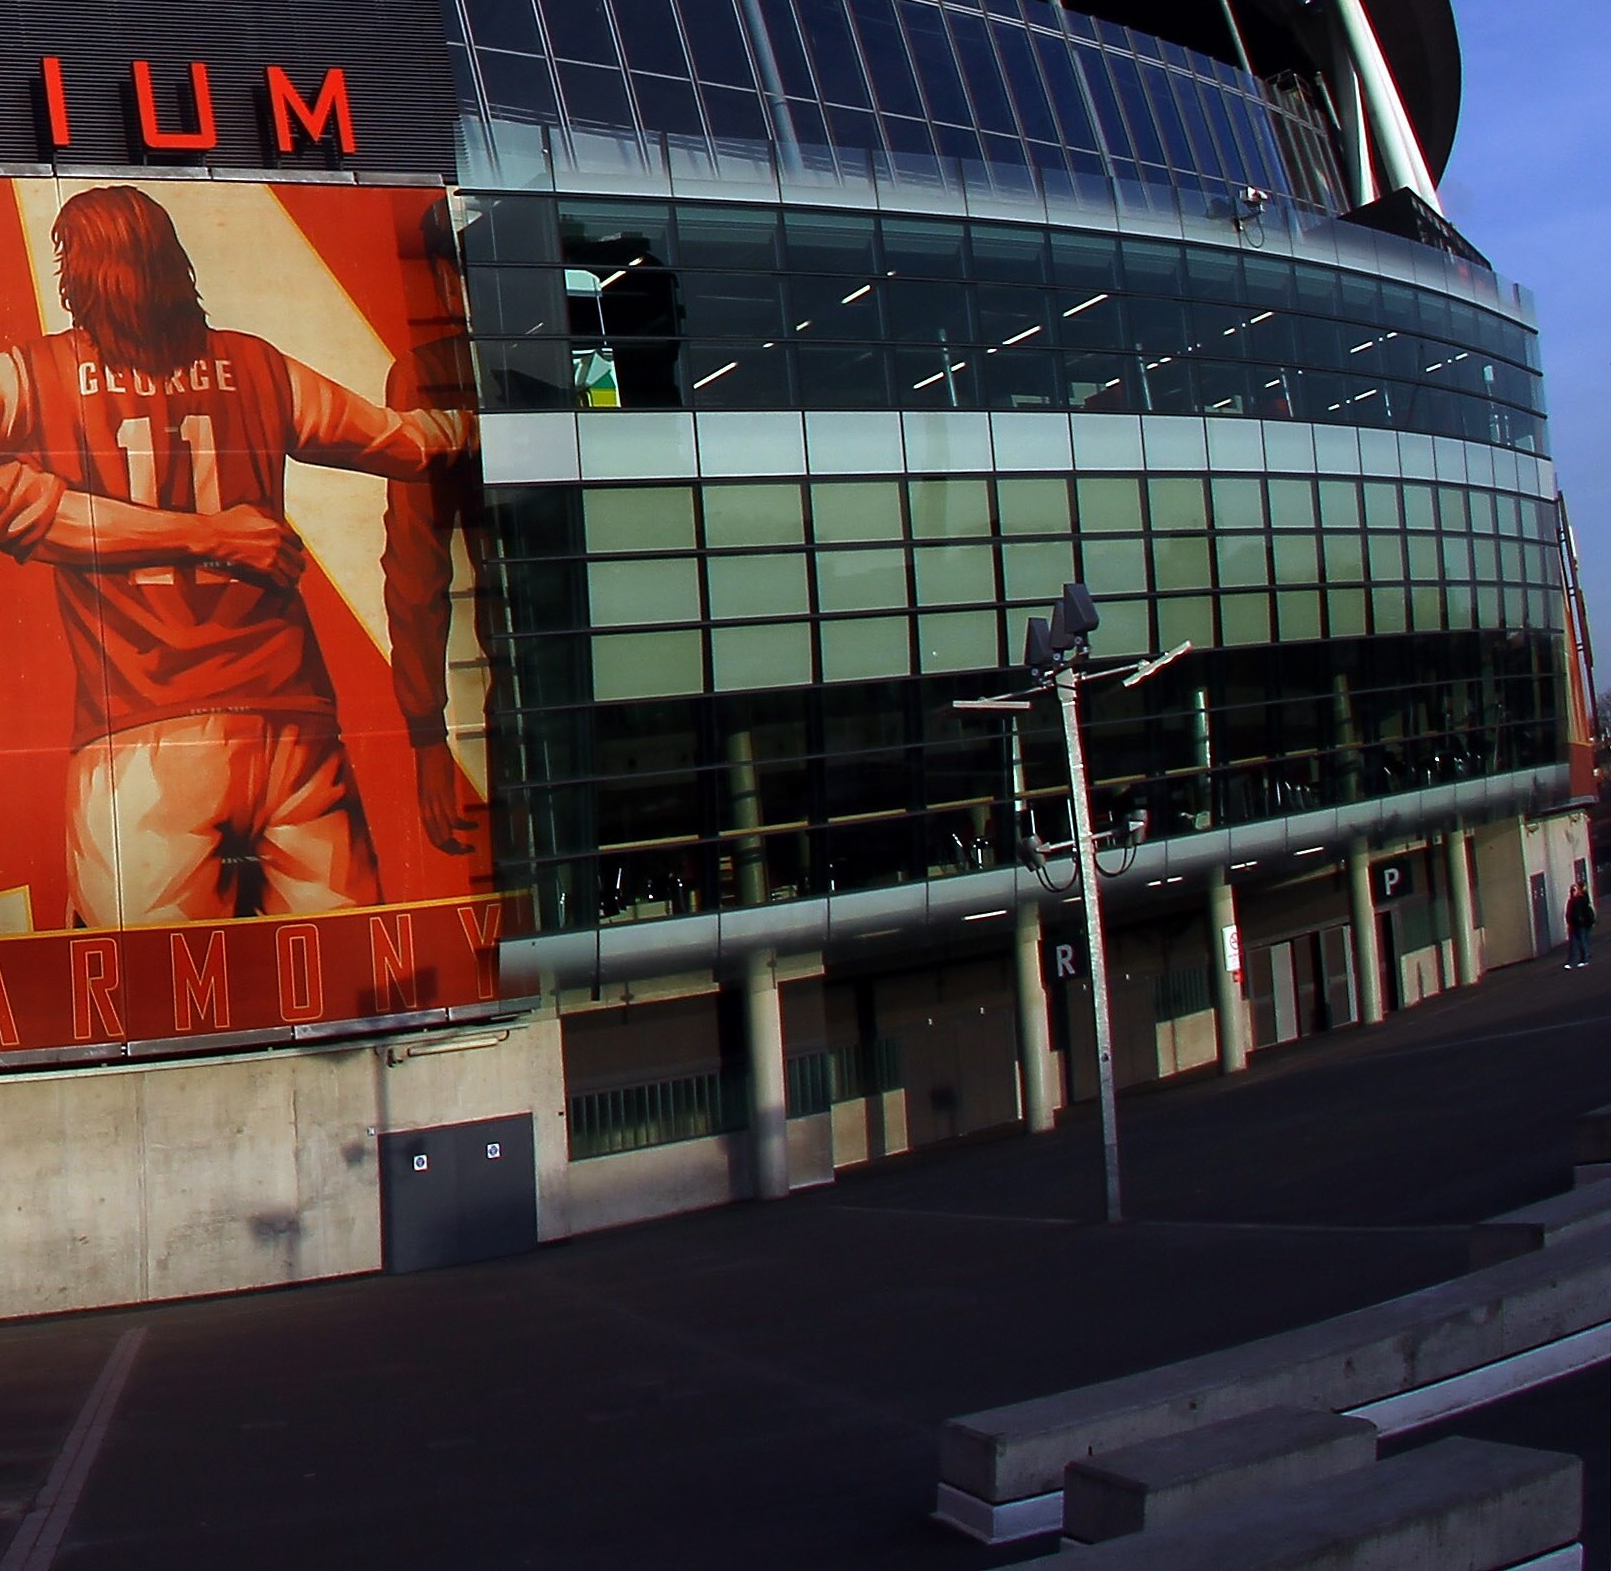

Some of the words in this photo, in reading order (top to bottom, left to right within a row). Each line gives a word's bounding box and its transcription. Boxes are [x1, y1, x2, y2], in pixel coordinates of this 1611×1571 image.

[116, 414, 241, 586] 11
[1383, 867, 1400, 896] P
[1055, 943, 1076, 978] R
